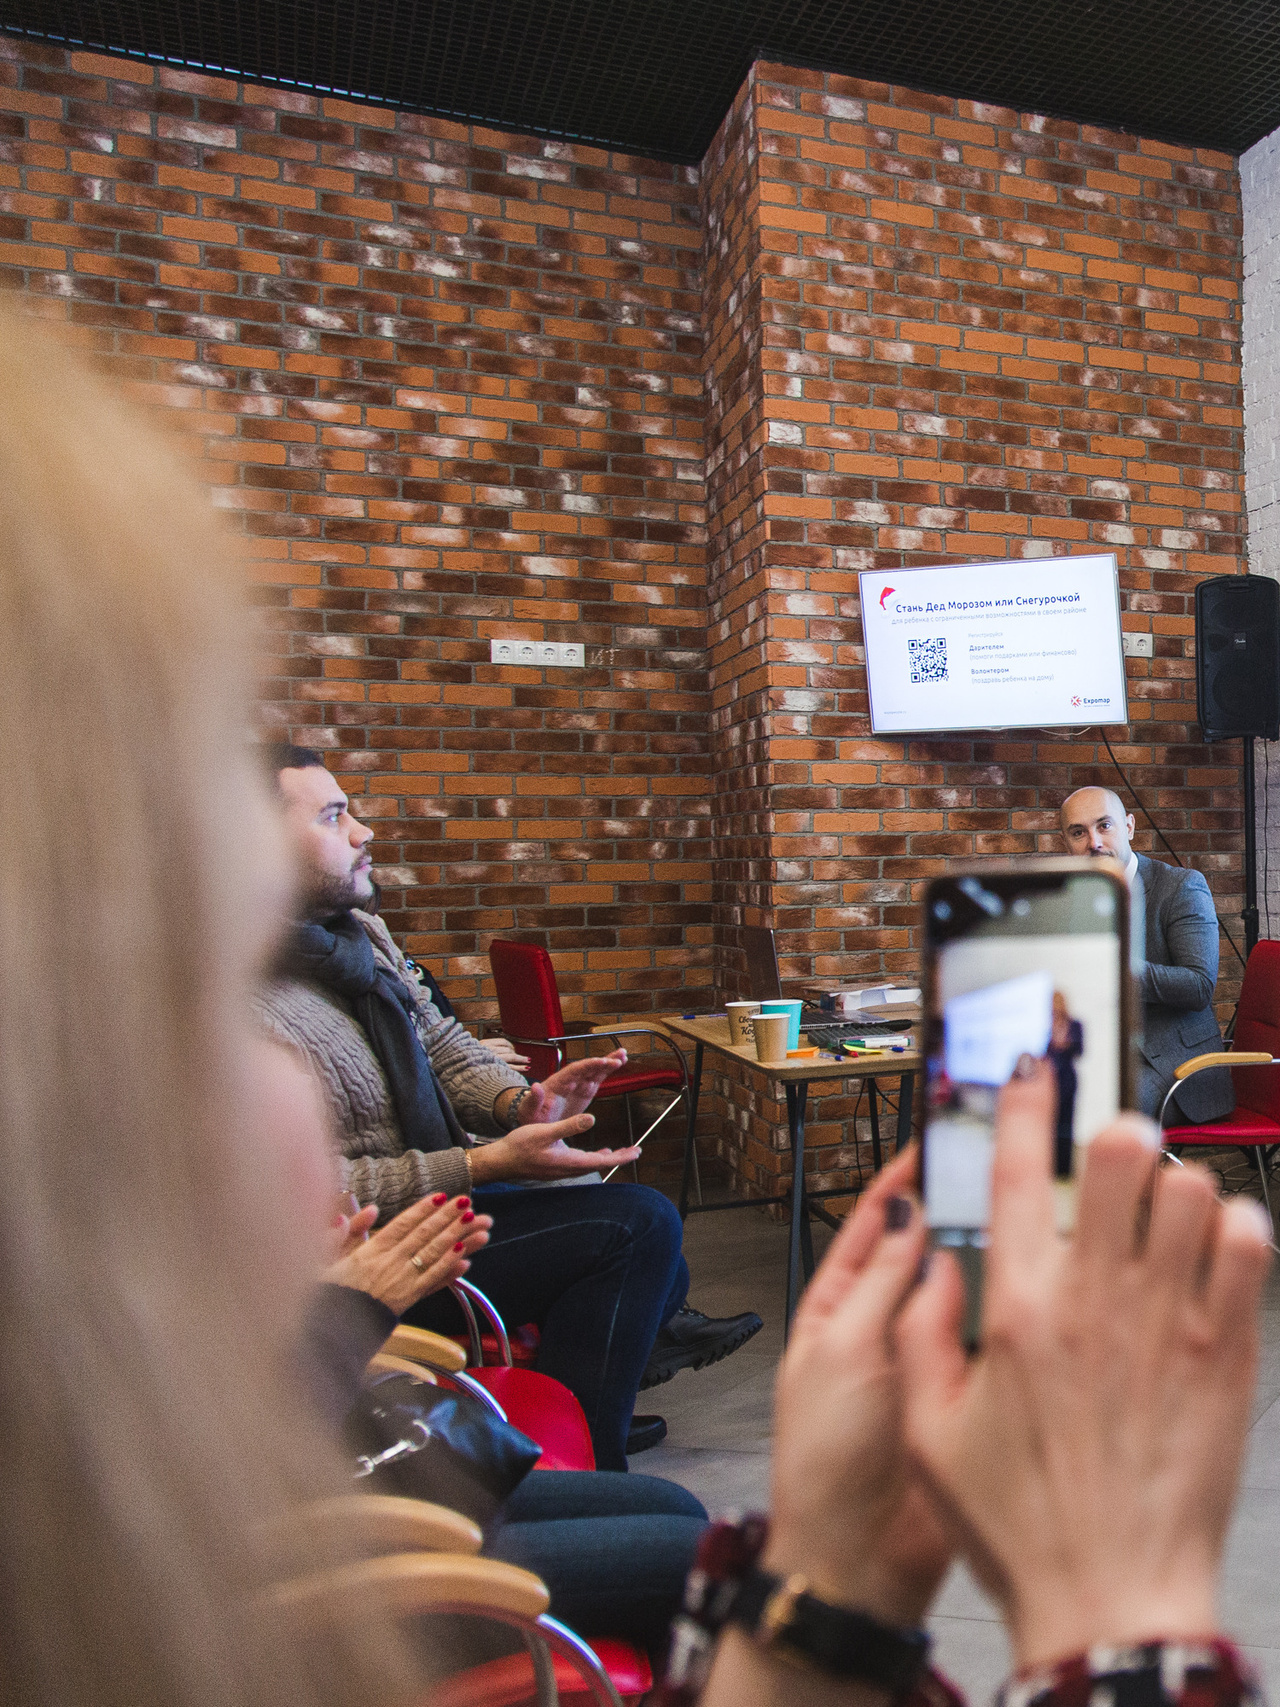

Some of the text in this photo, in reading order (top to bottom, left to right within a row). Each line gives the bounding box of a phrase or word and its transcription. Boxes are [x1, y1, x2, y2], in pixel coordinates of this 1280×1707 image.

[896, 592, 1080, 613] Стань Дед Морозом или Снегурочкой
[969, 644, 1004, 652] Дарителем
